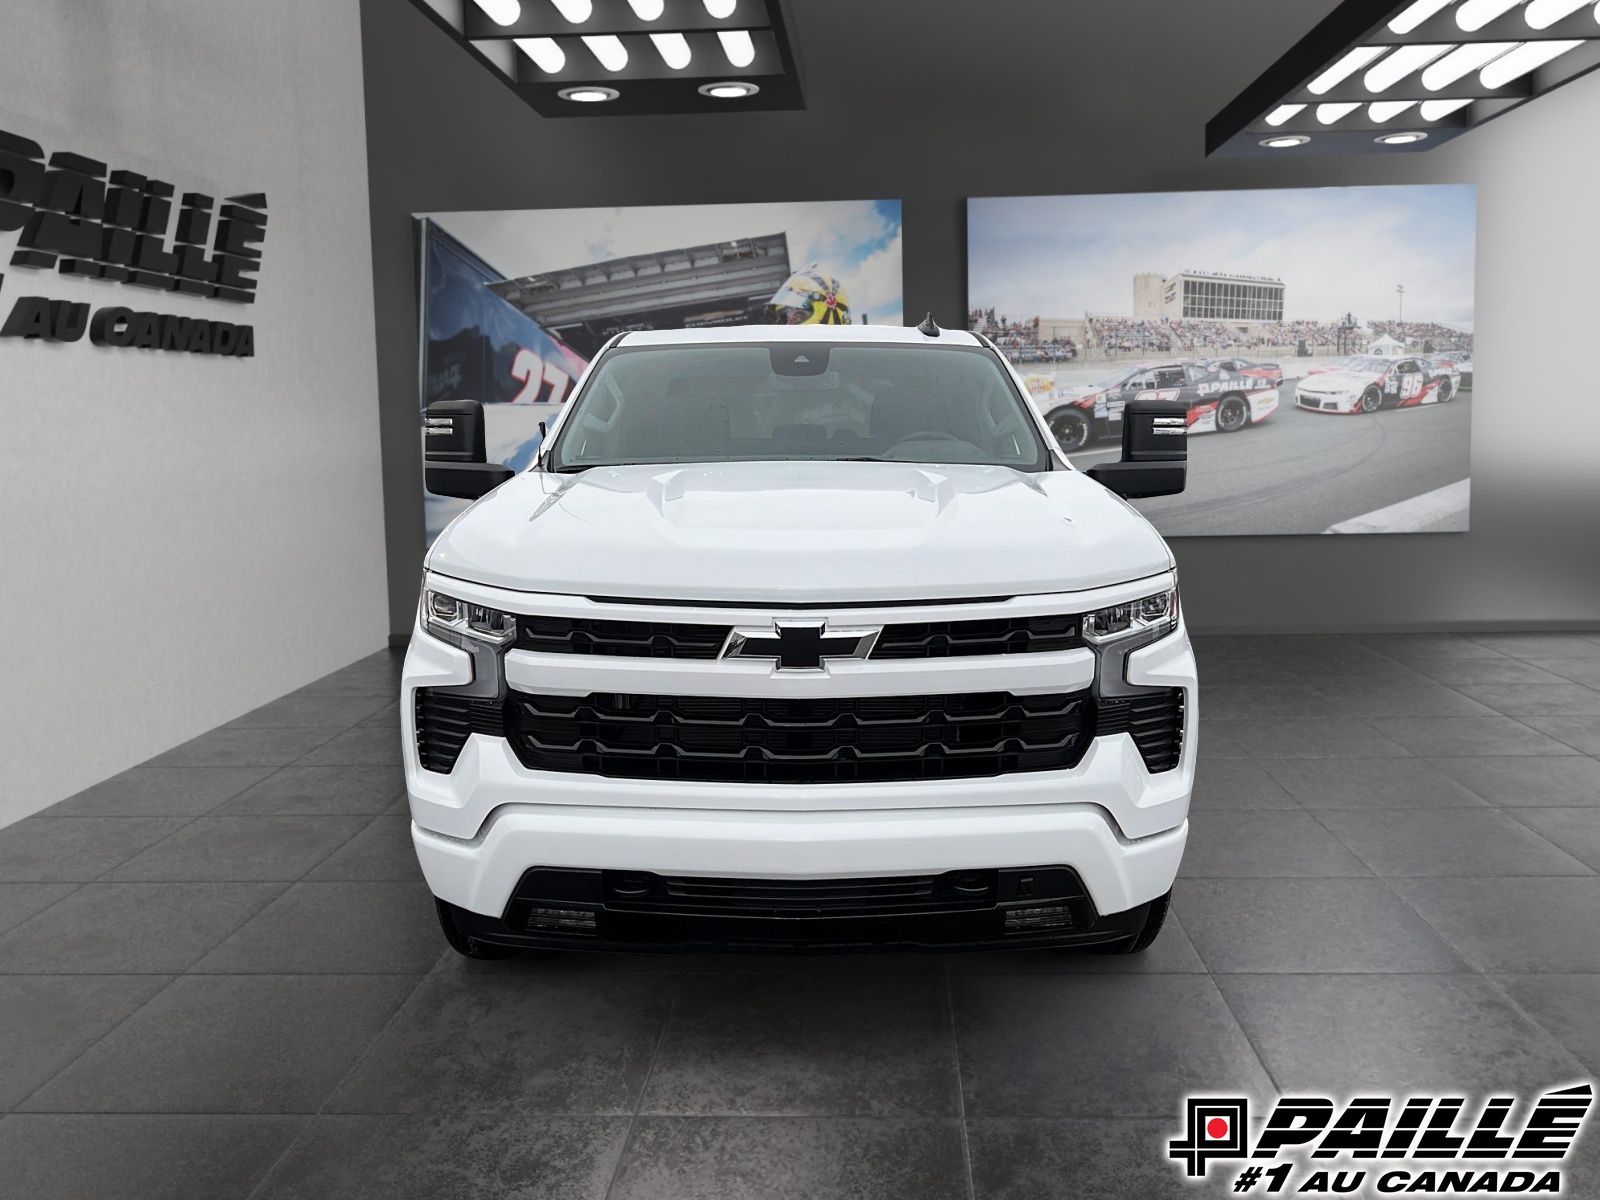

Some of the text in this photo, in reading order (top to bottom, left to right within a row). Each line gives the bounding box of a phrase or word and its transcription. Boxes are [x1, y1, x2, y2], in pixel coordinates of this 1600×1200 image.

[0, 296, 255, 357] AU CANADA
[511, 348, 569, 404] 27
[1400, 373, 1424, 398] 96
